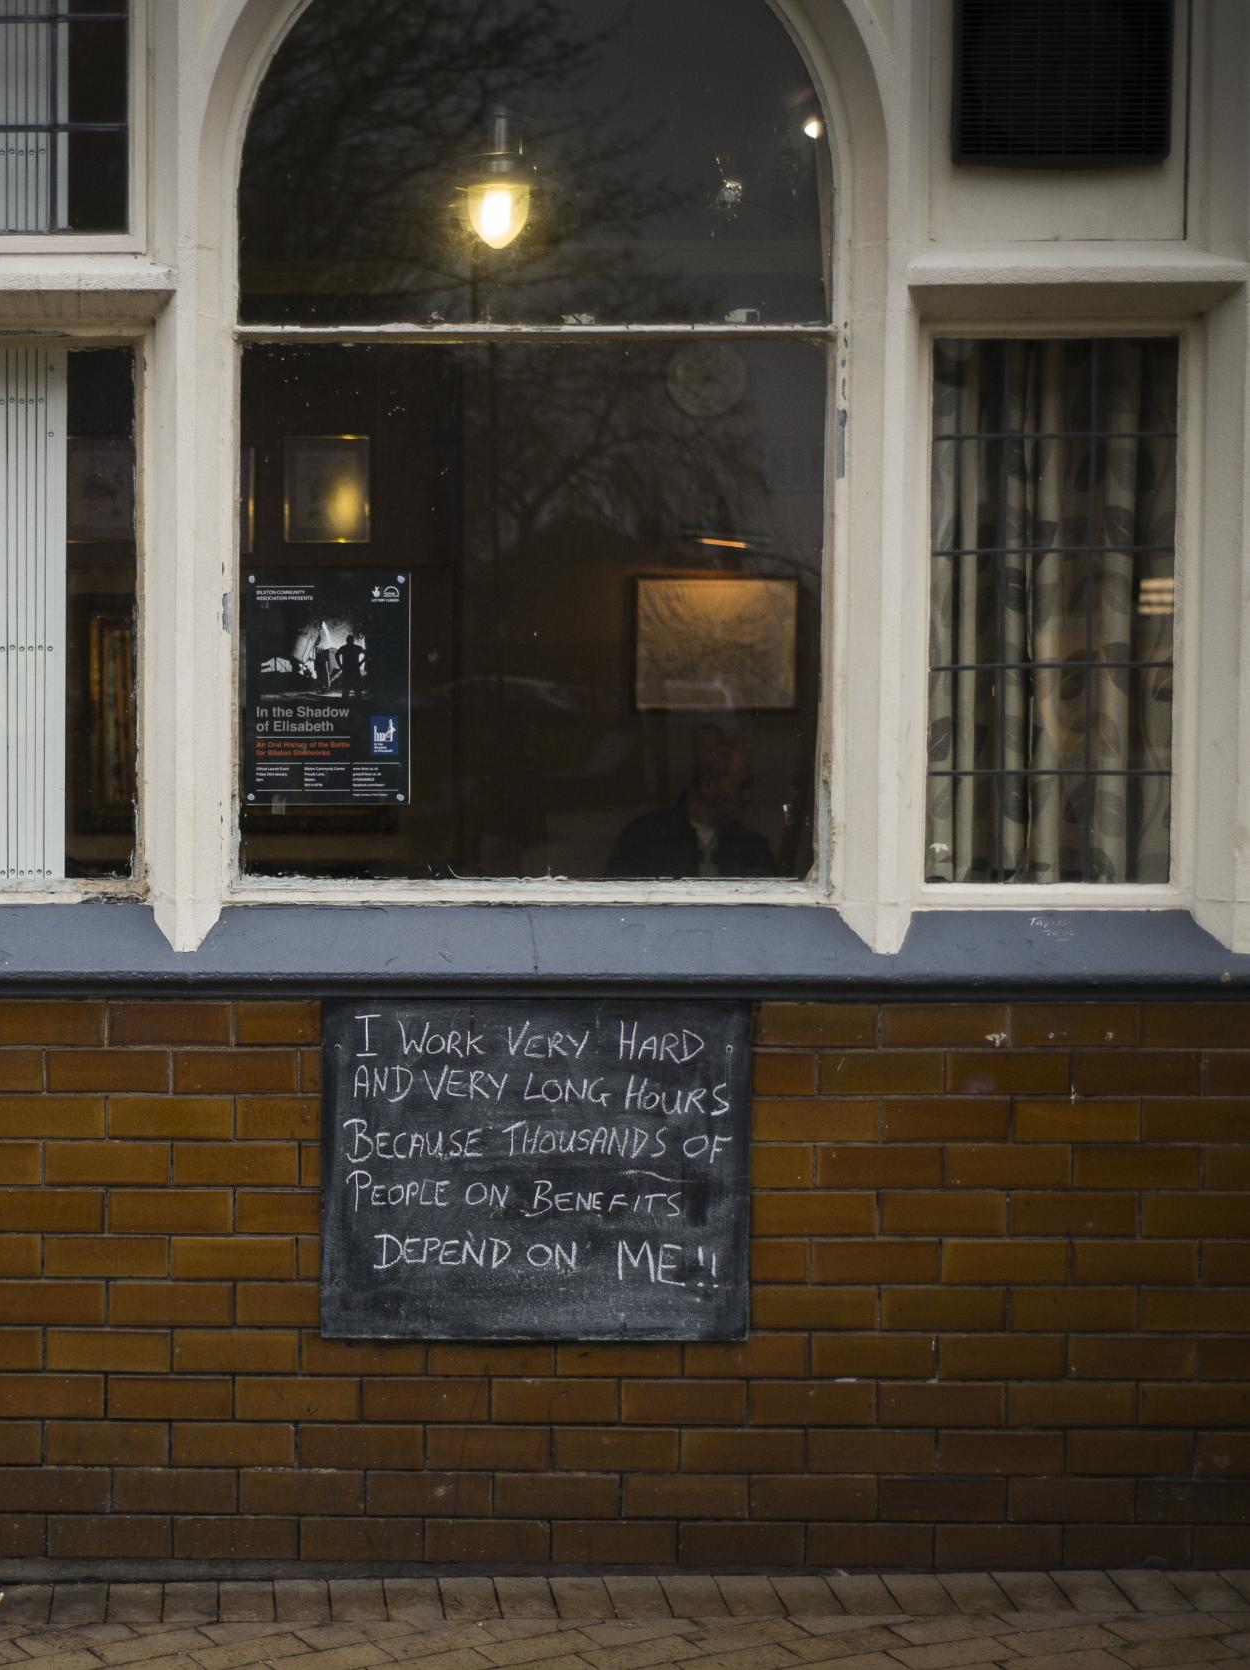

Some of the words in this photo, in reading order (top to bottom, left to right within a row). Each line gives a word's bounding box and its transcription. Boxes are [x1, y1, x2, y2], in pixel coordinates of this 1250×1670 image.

[256, 706, 268, 718] In
[272, 706, 293, 718] the
[296, 706, 350, 718] Shadow
[256, 721, 270, 732] of
[273, 721, 334, 732] Elisabeth
[283, 741, 307, 749] History
[354, 1014, 381, 1057] I
[398, 1020, 486, 1059] WORK
[508, 1020, 589, 1059] VERY
[620, 1021, 705, 1064] HARD
[353, 1065, 413, 1102] AND
[423, 1065, 508, 1101] VERY
[523, 1073, 611, 1107] LONG
[624, 1074, 731, 1116] HOURS
[343, 1119, 485, 1164] BECAUSE
[502, 1121, 668, 1160] THOUSANDS
[682, 1135, 732, 1164] OF
[346, 1170, 450, 1213] PEOPLE
[465, 1182, 509, 1209] ON
[525, 1180, 682, 1218] BENEFITS
[373, 1233, 511, 1270] DEPEND
[526, 1241, 577, 1271] ON
